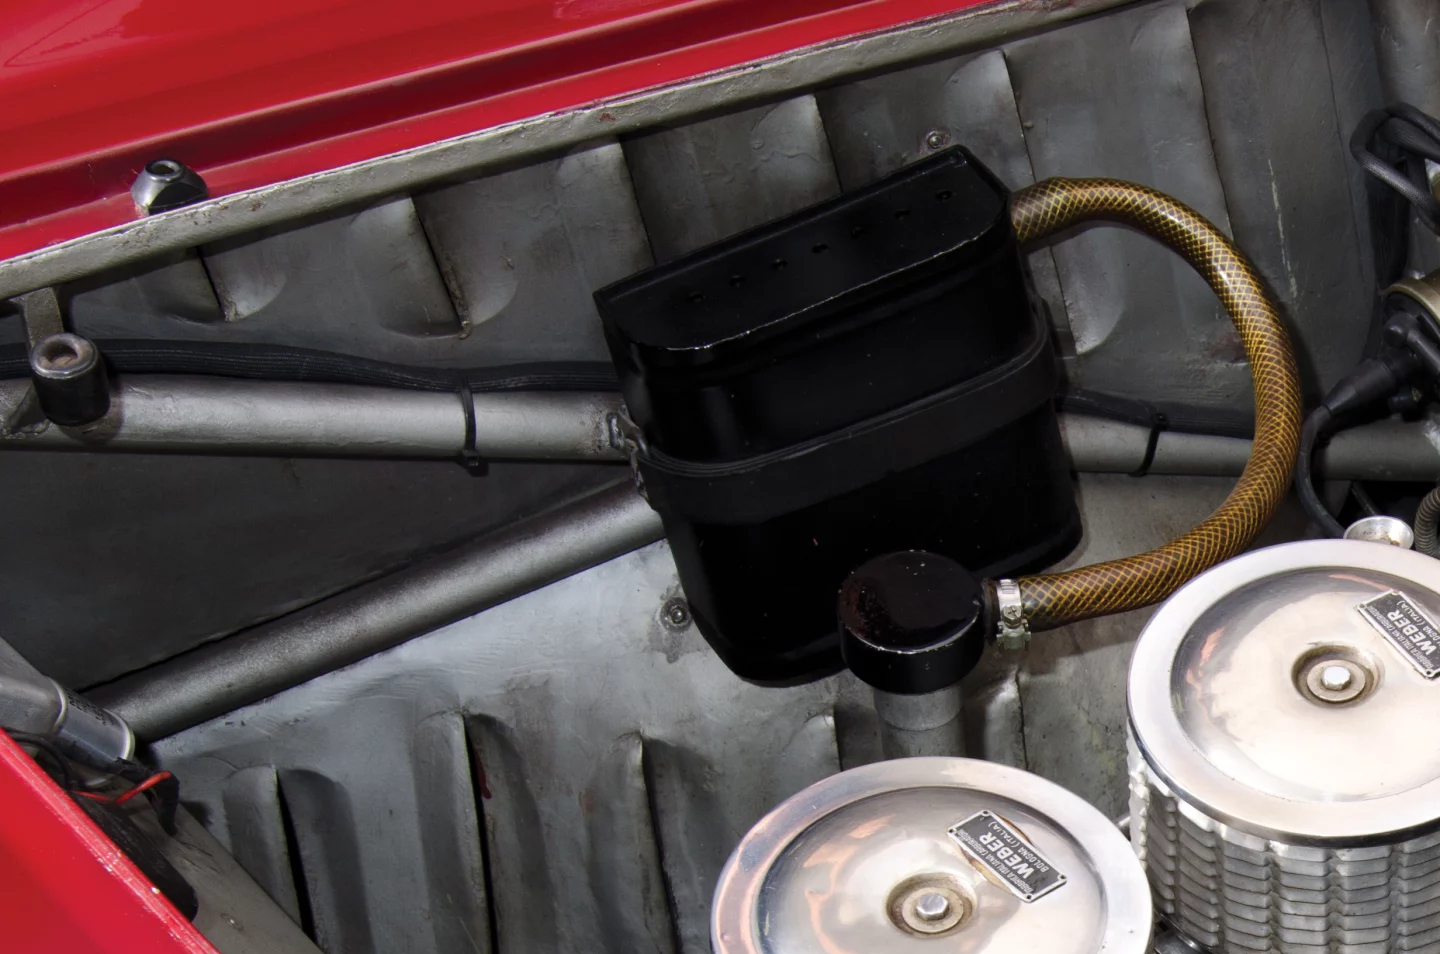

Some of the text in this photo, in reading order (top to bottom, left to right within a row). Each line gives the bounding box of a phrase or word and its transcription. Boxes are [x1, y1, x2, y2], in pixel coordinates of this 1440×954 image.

[1386, 609, 1437, 656] WEBER
[1396, 599, 1425, 626] (ITALIA)
[978, 830, 1035, 879] WEBER
[988, 820, 1050, 873] BOLOGNA (ITALIA)
